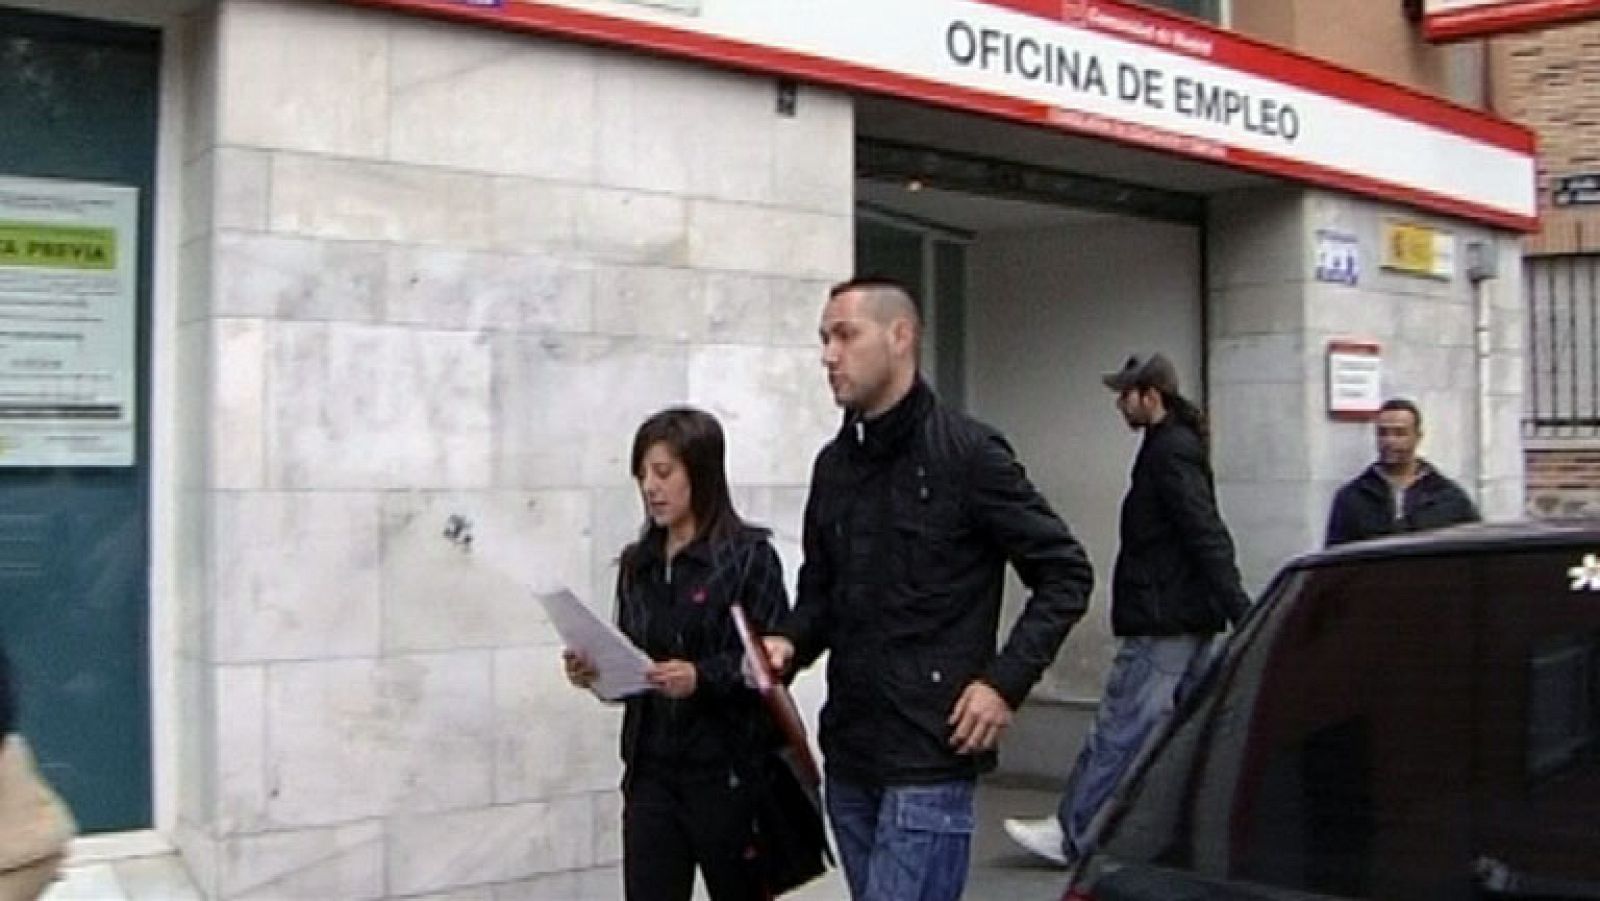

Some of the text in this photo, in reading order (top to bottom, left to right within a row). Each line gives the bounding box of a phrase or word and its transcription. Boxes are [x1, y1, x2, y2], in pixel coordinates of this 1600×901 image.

[946, 20, 1108, 96] OFICINA
[1117, 62, 1164, 109] DE
[1174, 75, 1300, 142] EMPLEO
[26, 241, 105, 262] PREVIA
